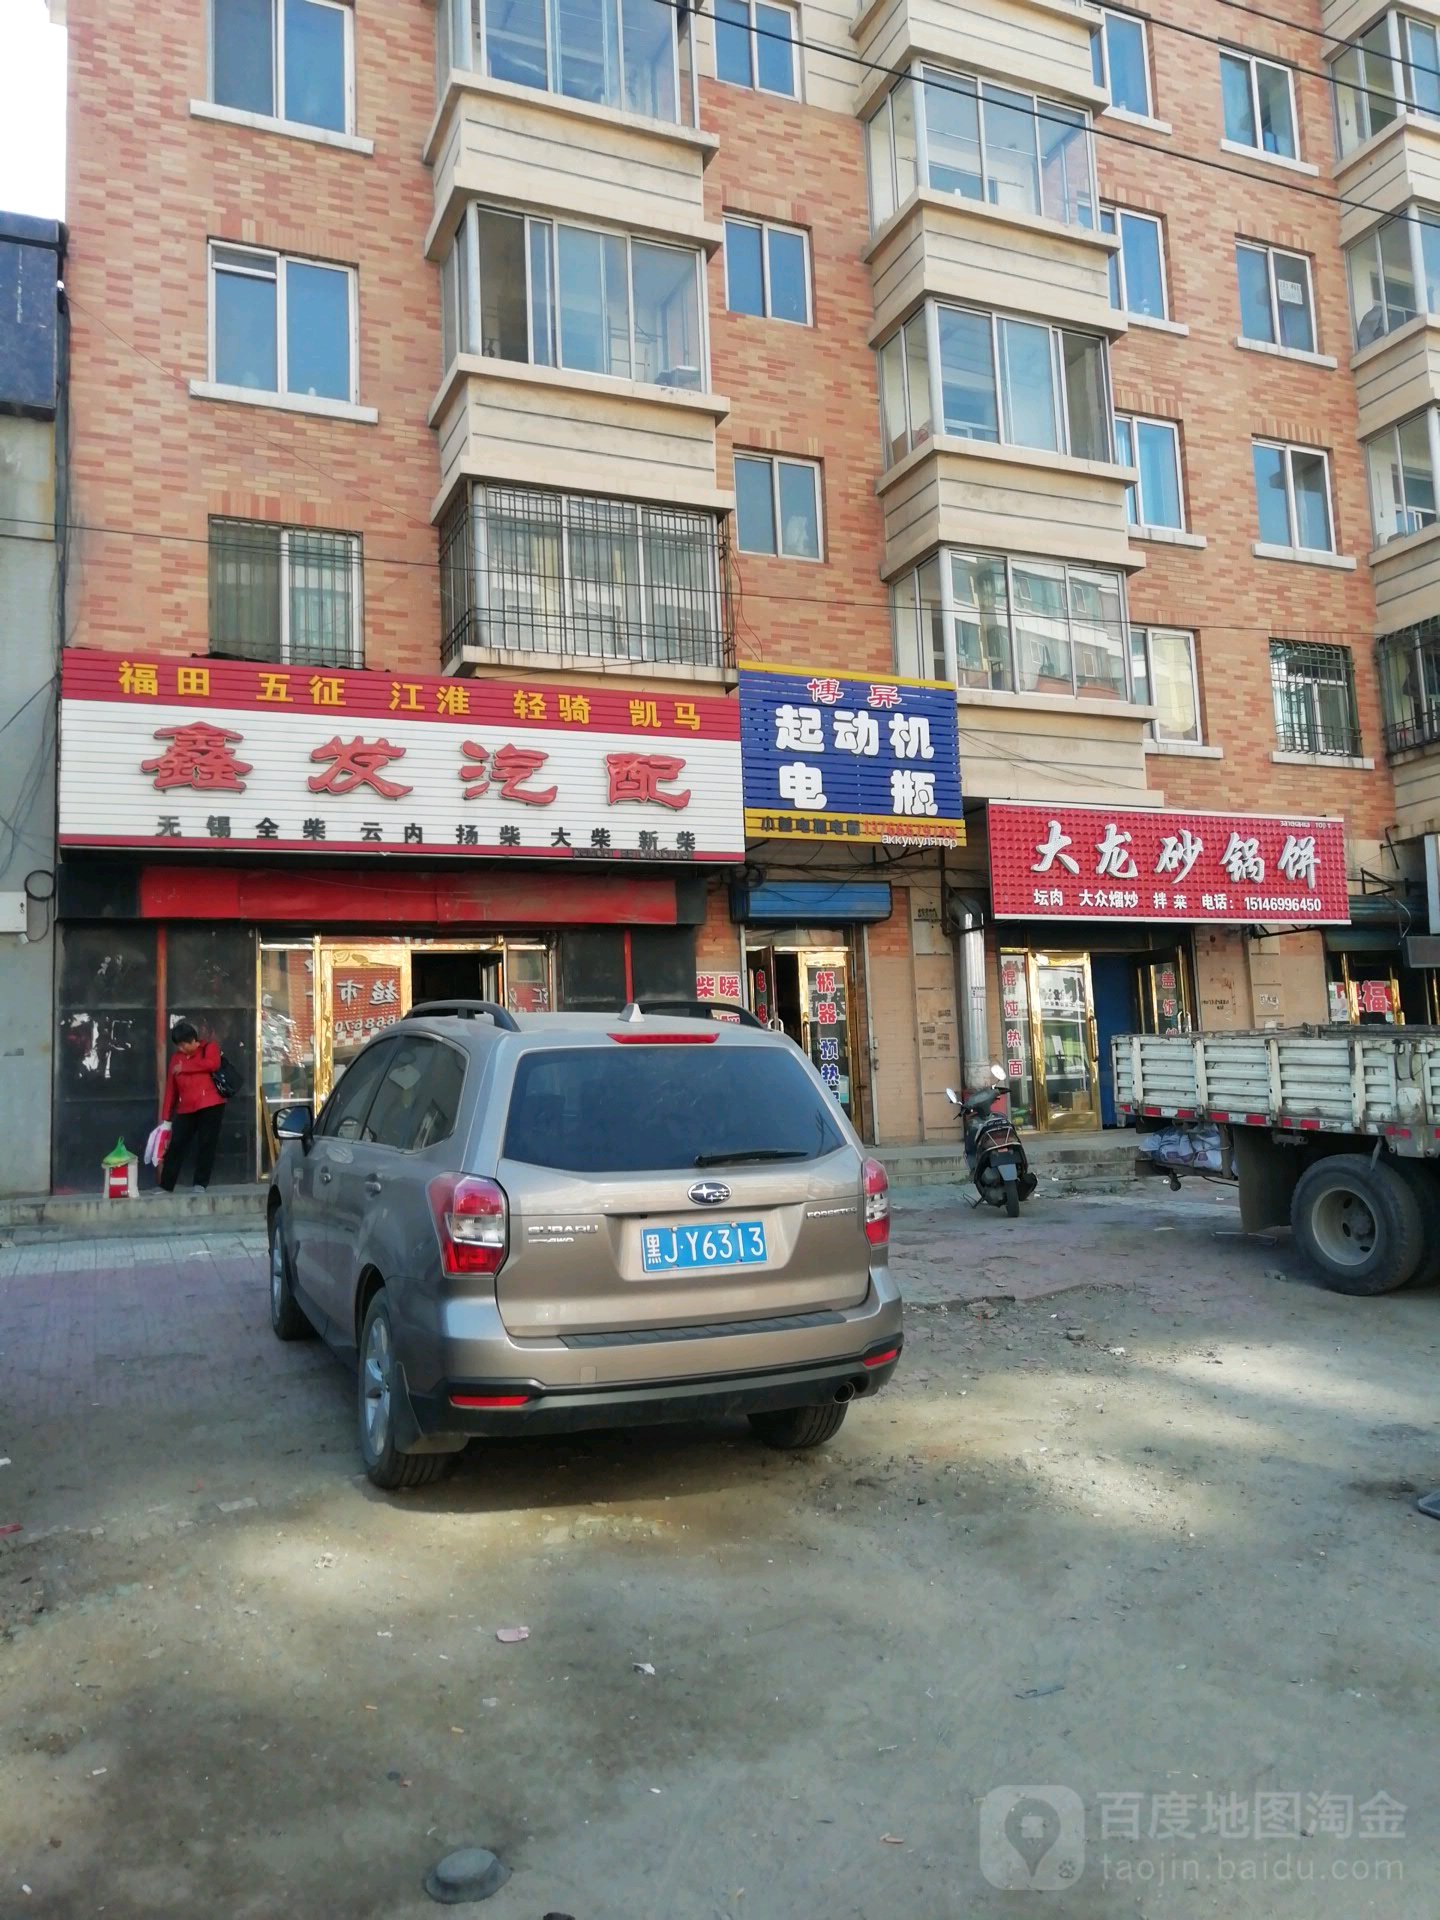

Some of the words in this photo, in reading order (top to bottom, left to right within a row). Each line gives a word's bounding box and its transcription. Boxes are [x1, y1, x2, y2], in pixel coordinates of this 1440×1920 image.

[117, 661, 210, 698] 福田
[775, 704, 934, 759] 起动机
[140, 721, 691, 811] 鑫发汽配
[1031, 819, 1321, 889] 大龙砂锅饼
[1033, 888, 1064, 907] 坛肉
[1244, 896, 1321, 912] 15146996450
